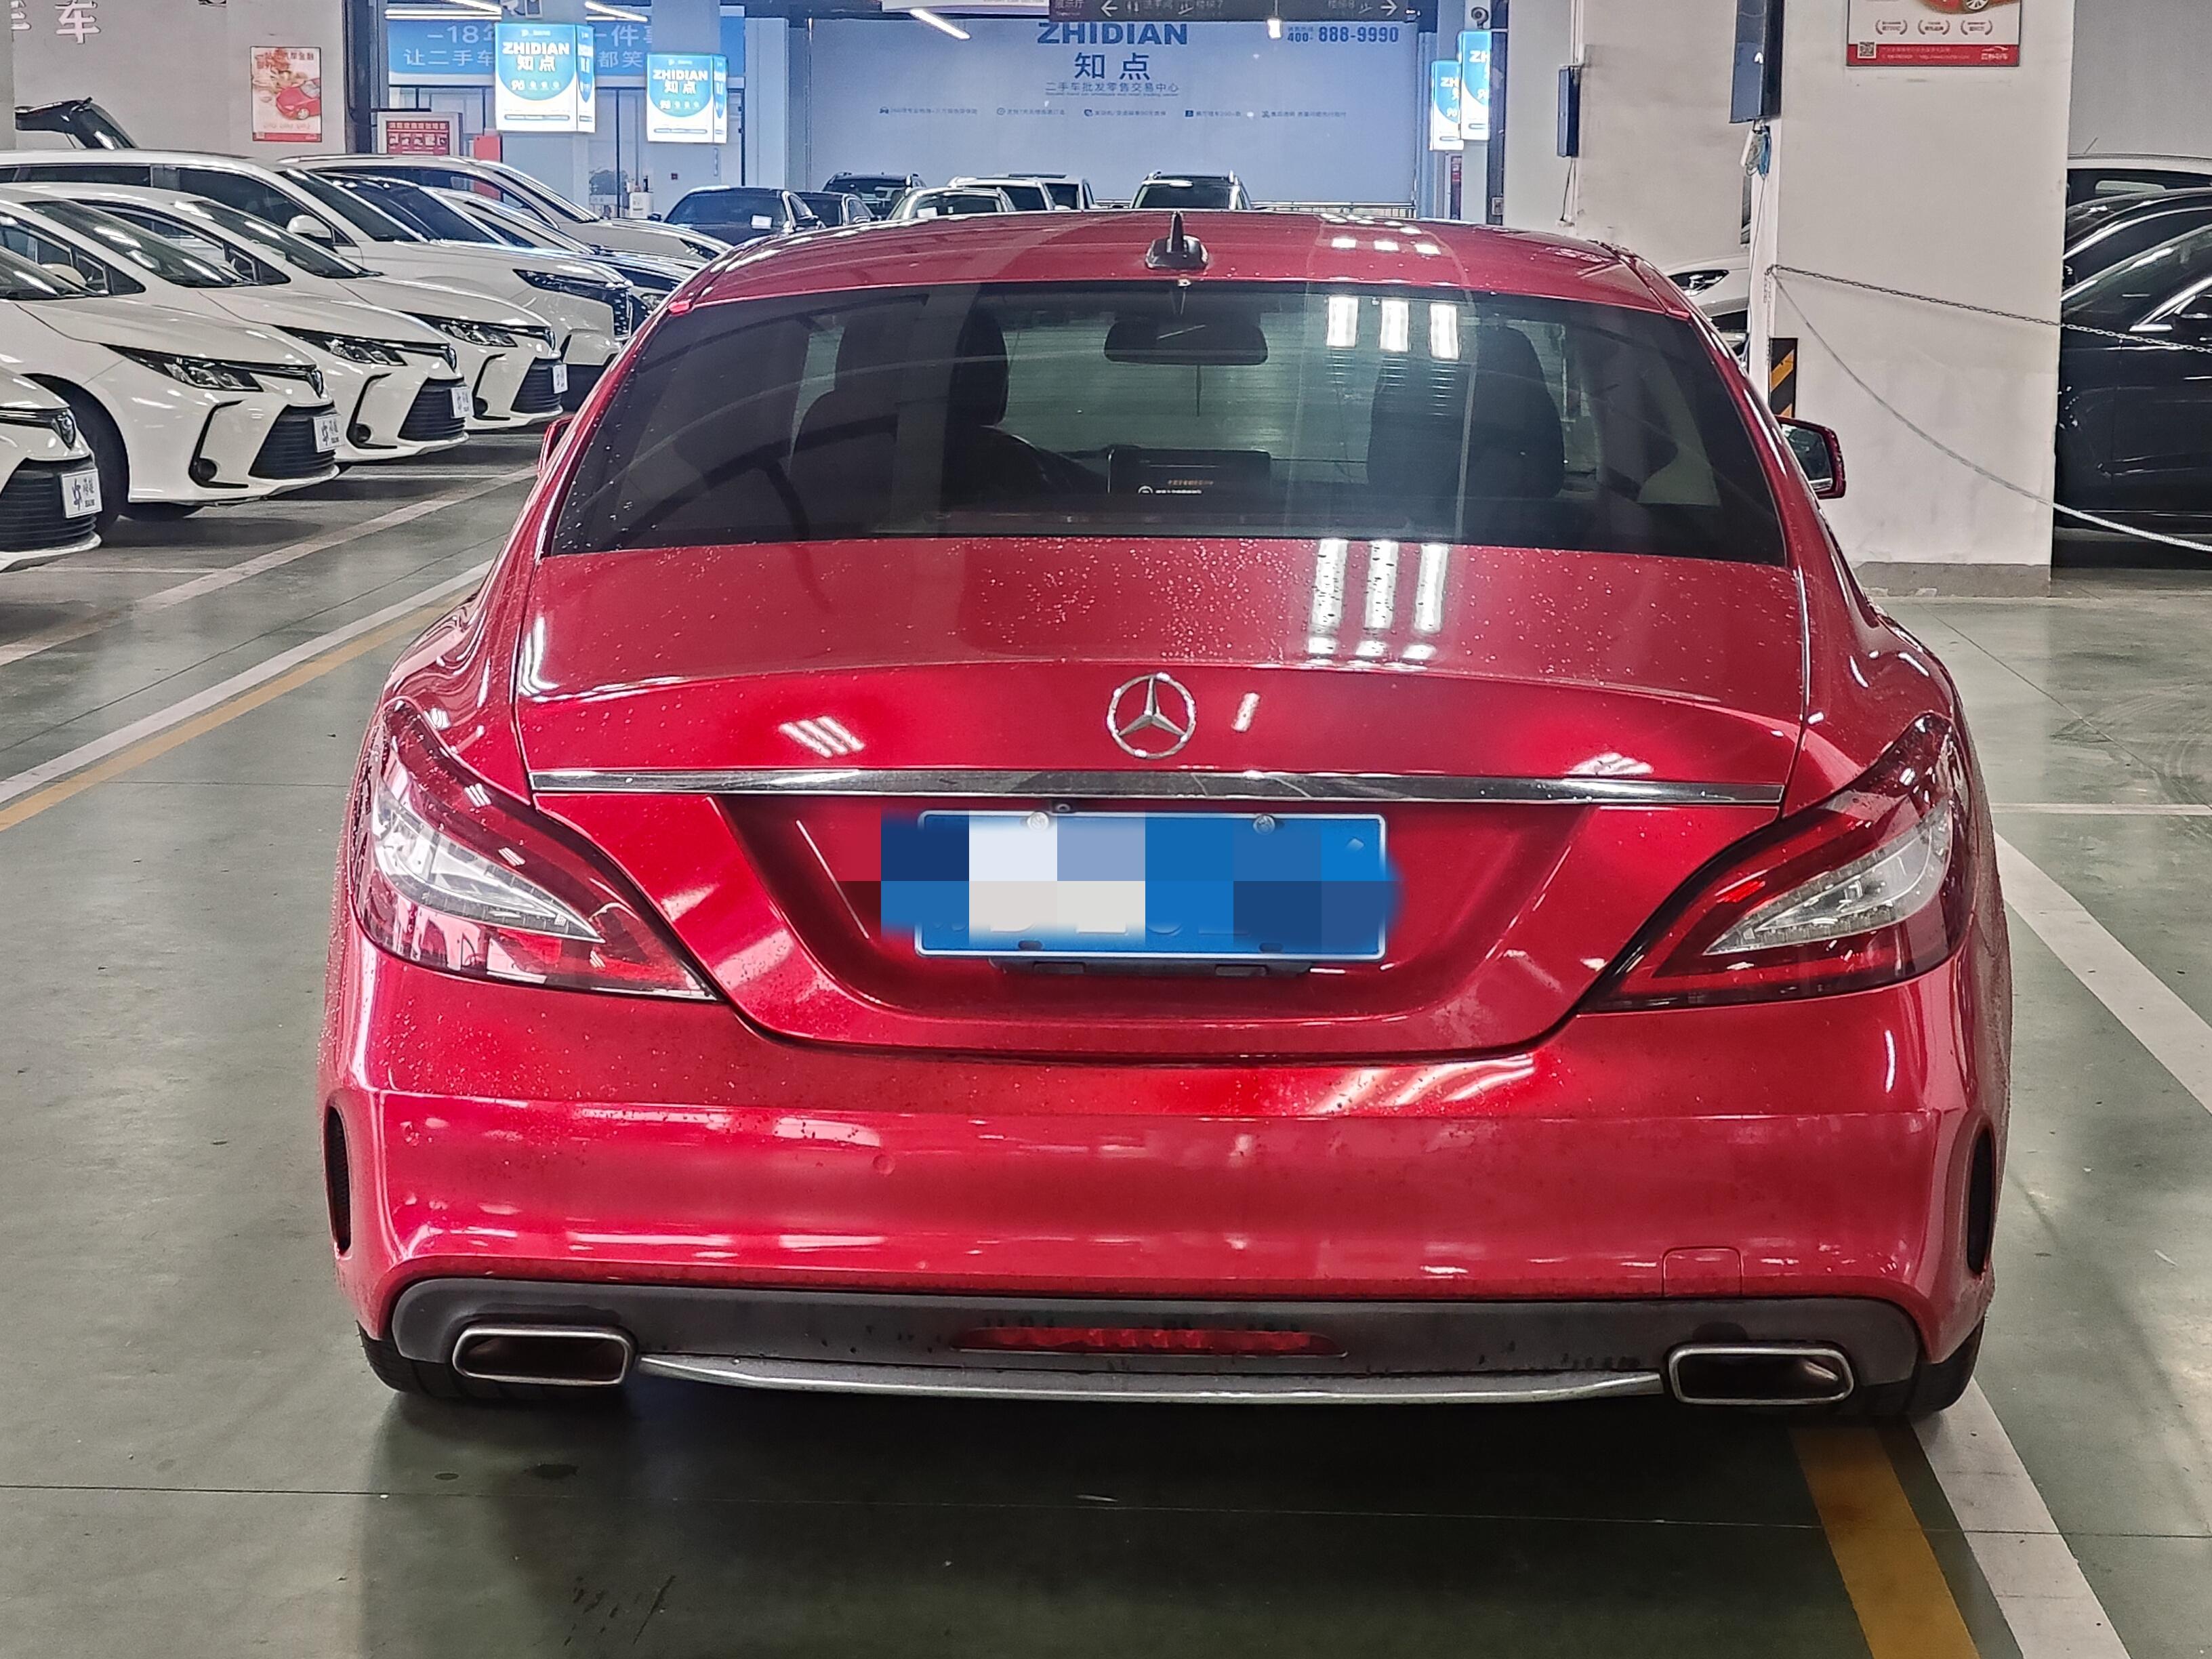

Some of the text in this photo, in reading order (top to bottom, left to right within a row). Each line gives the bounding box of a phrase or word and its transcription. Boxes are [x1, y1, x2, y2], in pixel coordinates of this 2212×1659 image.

[1038, 22, 1187, 45] ZHIDIAN
[1319, 26, 1399, 42] 888-9990
[502, 41, 569, 55] ZHIDIAN
[403, 48, 643, 68] 让二手车 都笑
[516, 55, 556, 72] 知点
[1074, 52, 1151, 81] 知点
[653, 70, 708, 81] ZHIDIAN
[664, 81, 696, 94] 知点
[1045, 82, 1179, 93] 二手车批发零售交易中心
